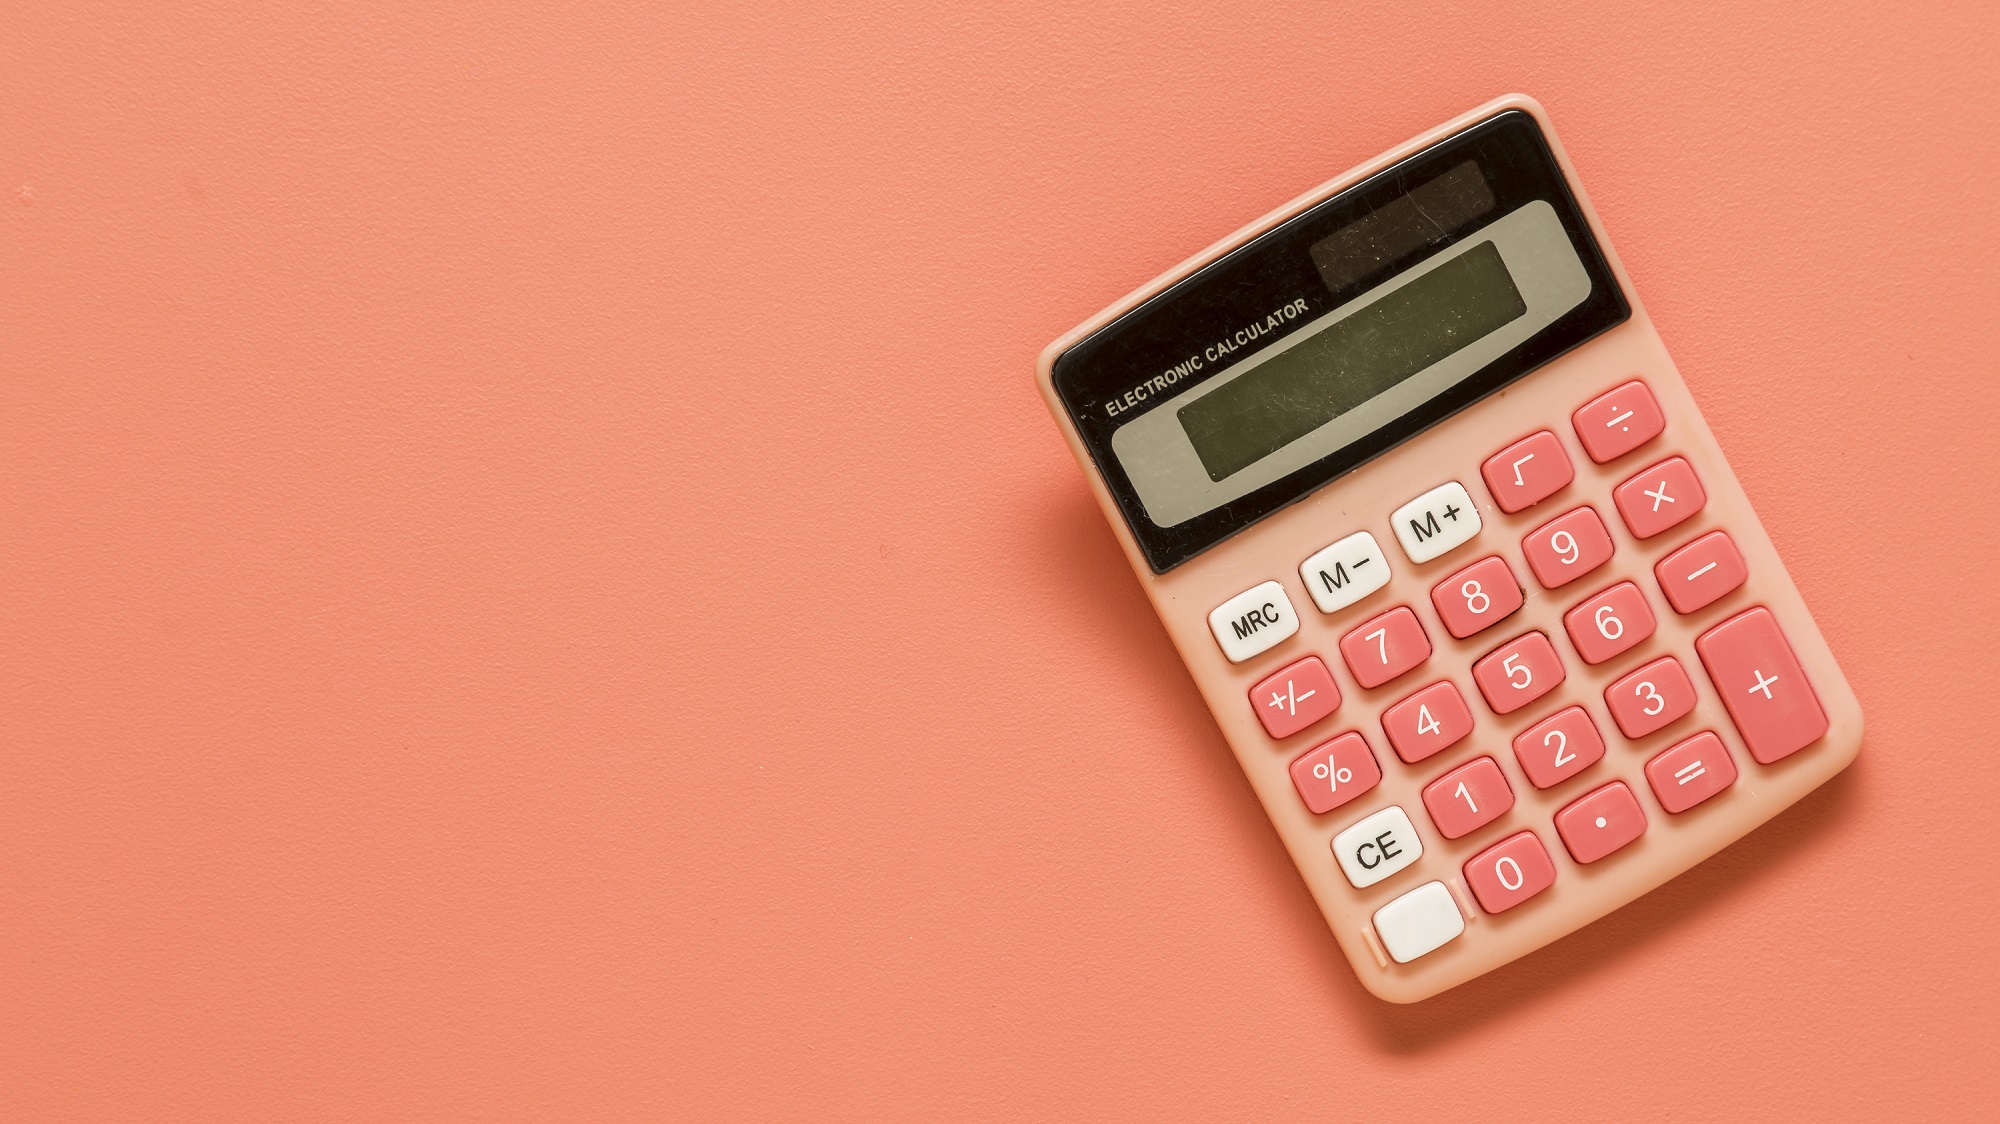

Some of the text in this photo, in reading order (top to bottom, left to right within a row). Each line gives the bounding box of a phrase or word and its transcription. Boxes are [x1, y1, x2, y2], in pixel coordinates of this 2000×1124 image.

[1105, 298, 1309, 417] ELECTRONIC CALCULATOR
[1550, 530, 1579, 565] 9
[1461, 579, 1491, 614] 8
[1230, 602, 1279, 640] MRC
[1594, 605, 1624, 640] 6
[1364, 627, 1389, 665] 7
[1502, 652, 1533, 690] 5
[1635, 681, 1665, 716] 3
[1417, 703, 1441, 736] 4
[1543, 729, 1577, 768] 2
[1312, 754, 1353, 793] %
[1454, 781, 1479, 814] 1
[1356, 830, 1402, 870] CE
[1495, 856, 1524, 891] 0
